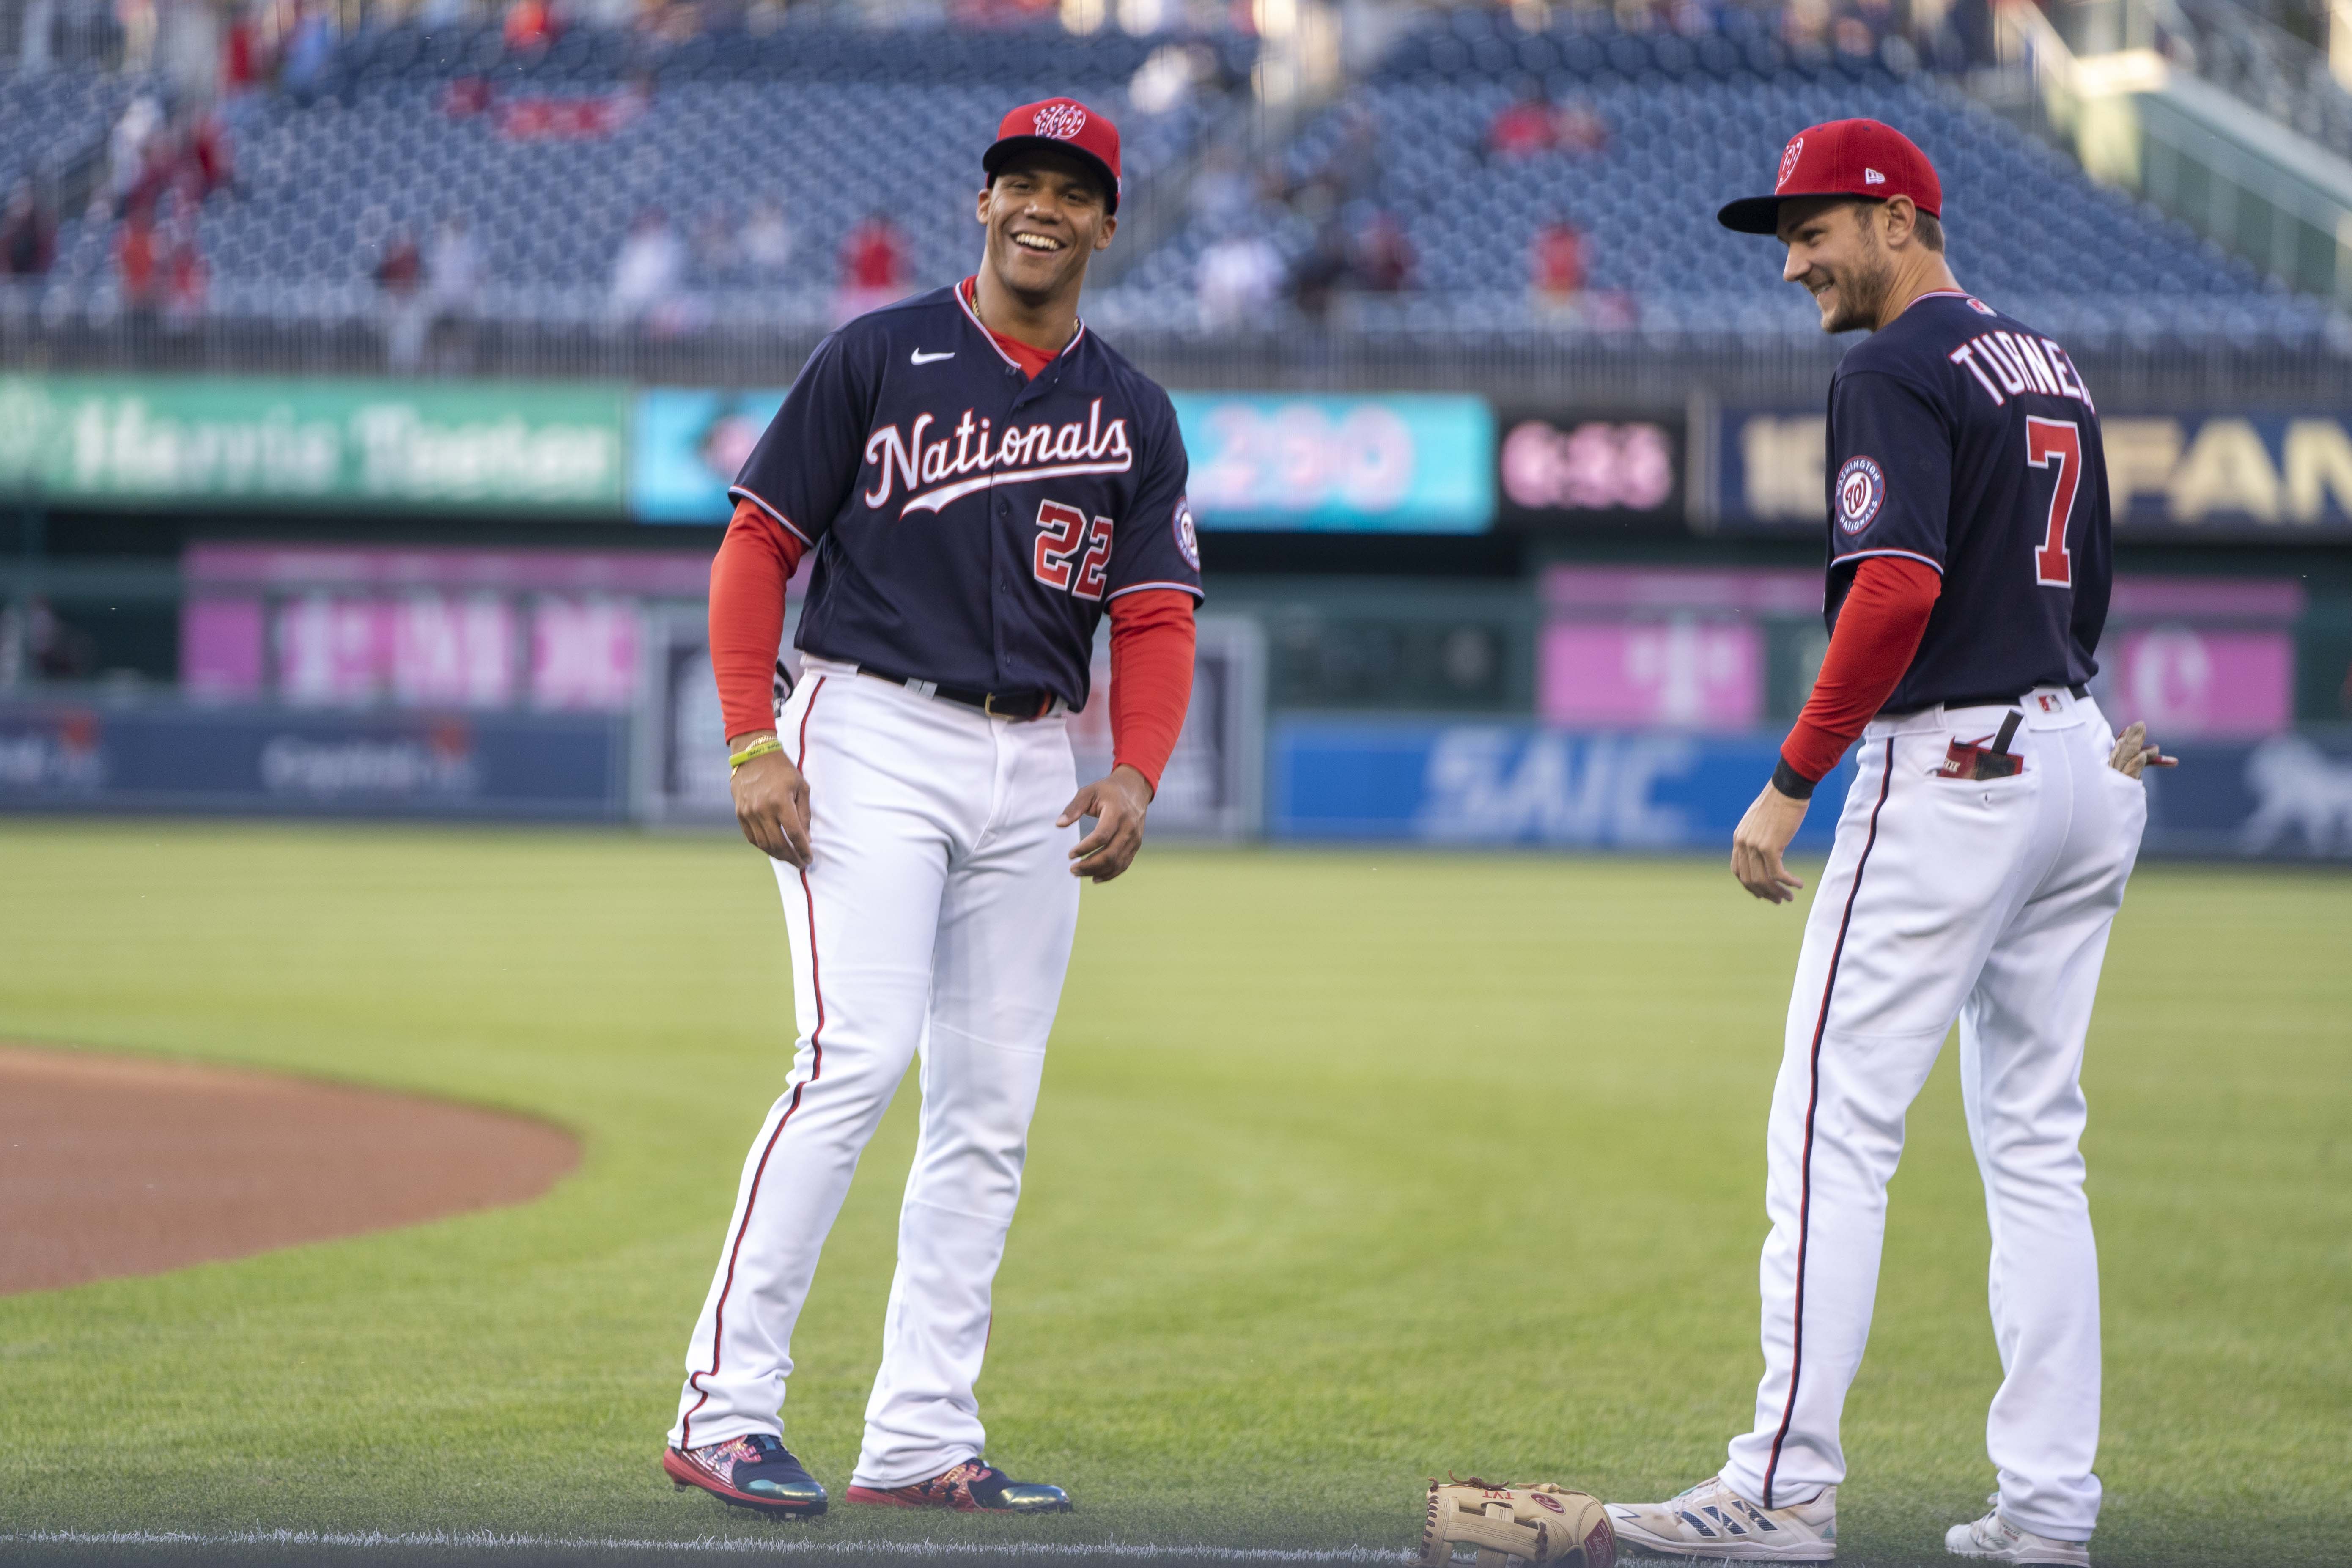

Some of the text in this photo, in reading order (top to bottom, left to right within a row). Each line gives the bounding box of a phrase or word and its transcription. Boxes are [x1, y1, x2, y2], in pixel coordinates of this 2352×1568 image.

[1948, 330, 2096, 417] TURNE
[865, 406, 1132, 509] Nationals
[1837, 459, 1880, 497] WASHINGTON
[1840, 500, 1878, 532] NATIONALS
[2026, 415, 2082, 589] 7
[1034, 499, 1113, 601] 22
[1482, 1490, 1515, 1500] TVT
